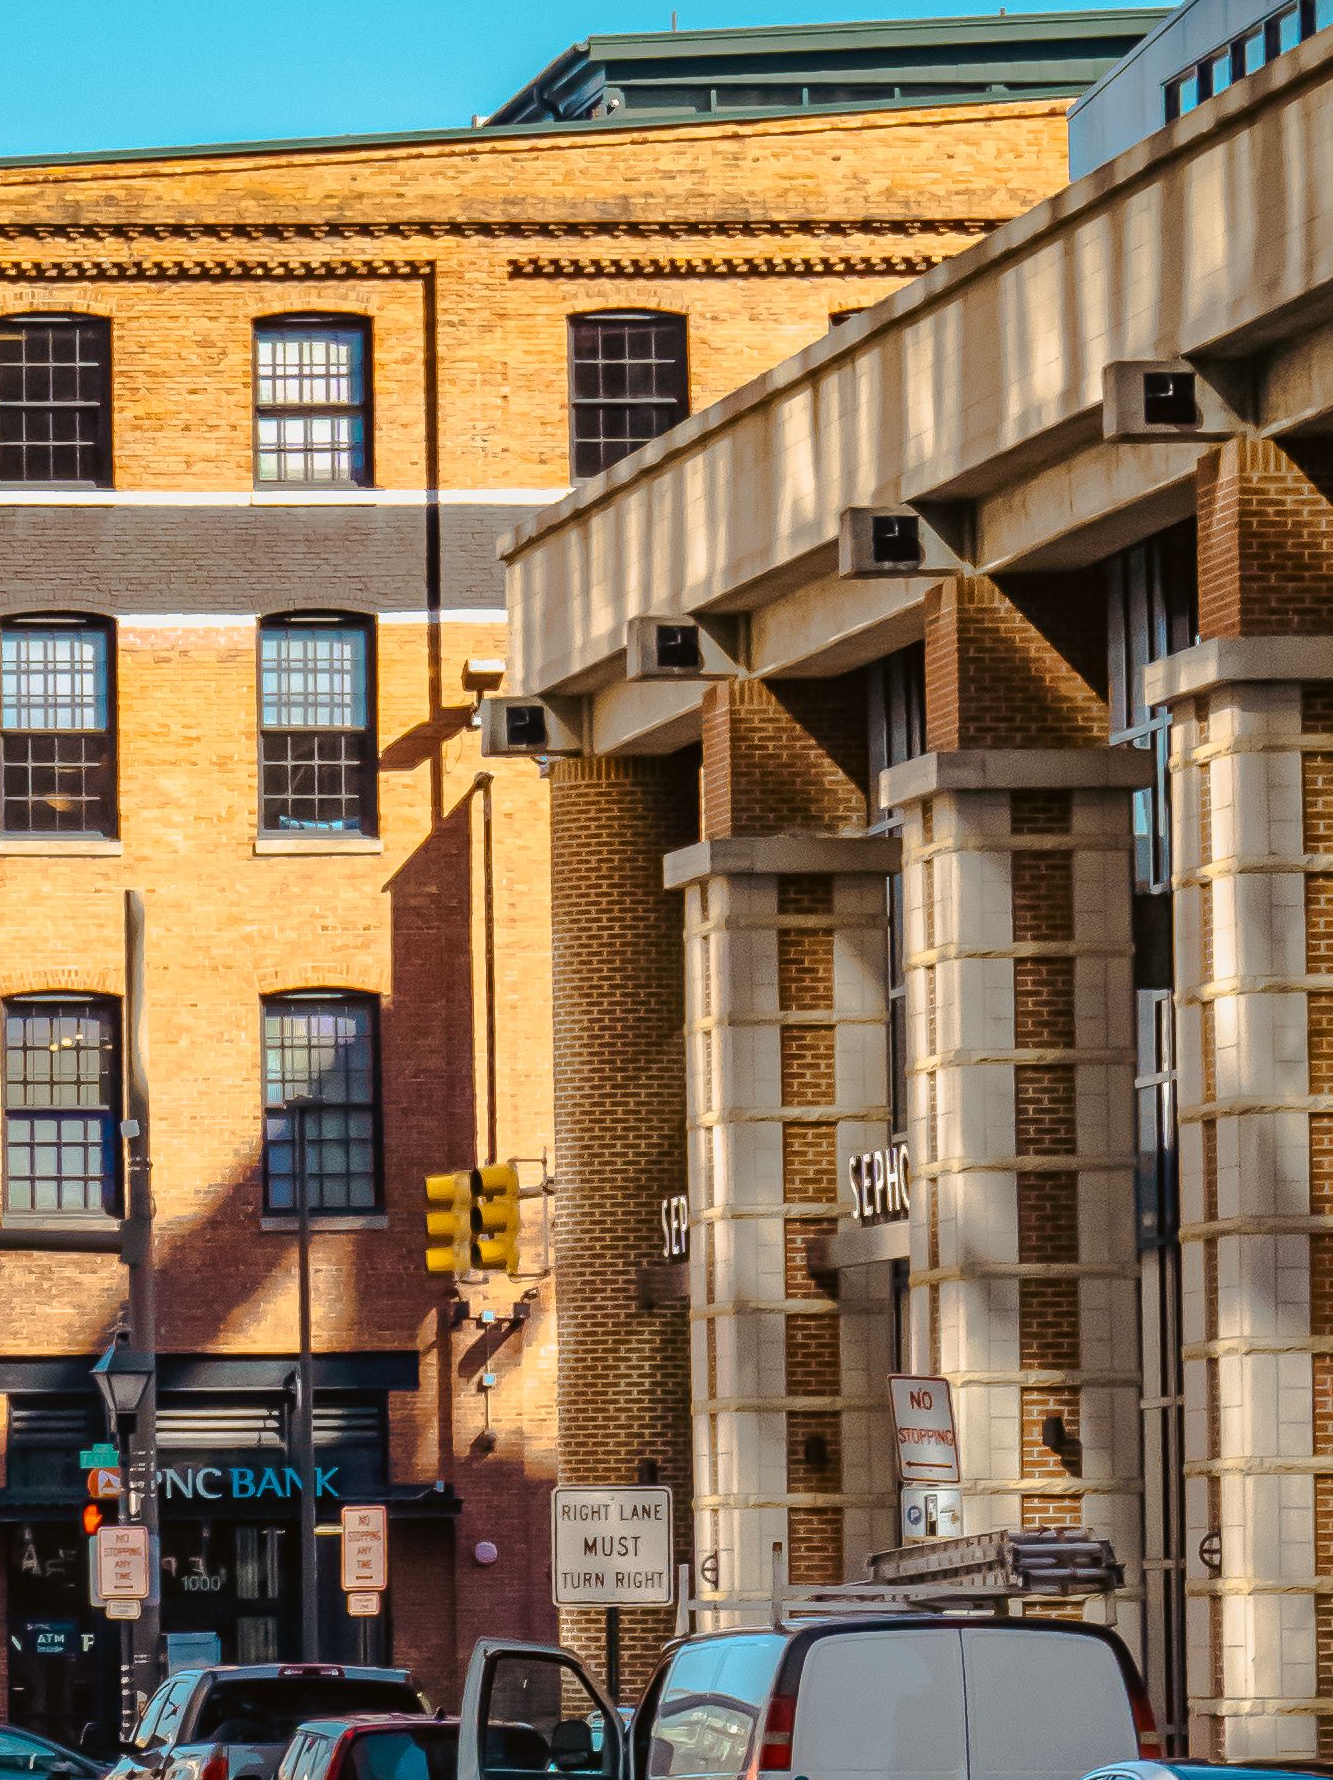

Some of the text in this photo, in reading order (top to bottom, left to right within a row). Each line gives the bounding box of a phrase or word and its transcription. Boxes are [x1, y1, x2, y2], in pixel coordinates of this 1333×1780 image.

[909, 1389, 933, 1411] NO
[898, 1426, 955, 1446] STOPPING
[562, 1504, 664, 1521] RIGHT LANE
[115, 1534, 130, 1543] NO
[583, 1536, 641, 1557] MUST
[182, 1575, 221, 1591] 1000
[561, 1571, 664, 1589] TURN RIGHT
[37, 1633, 65, 1643] ATM
